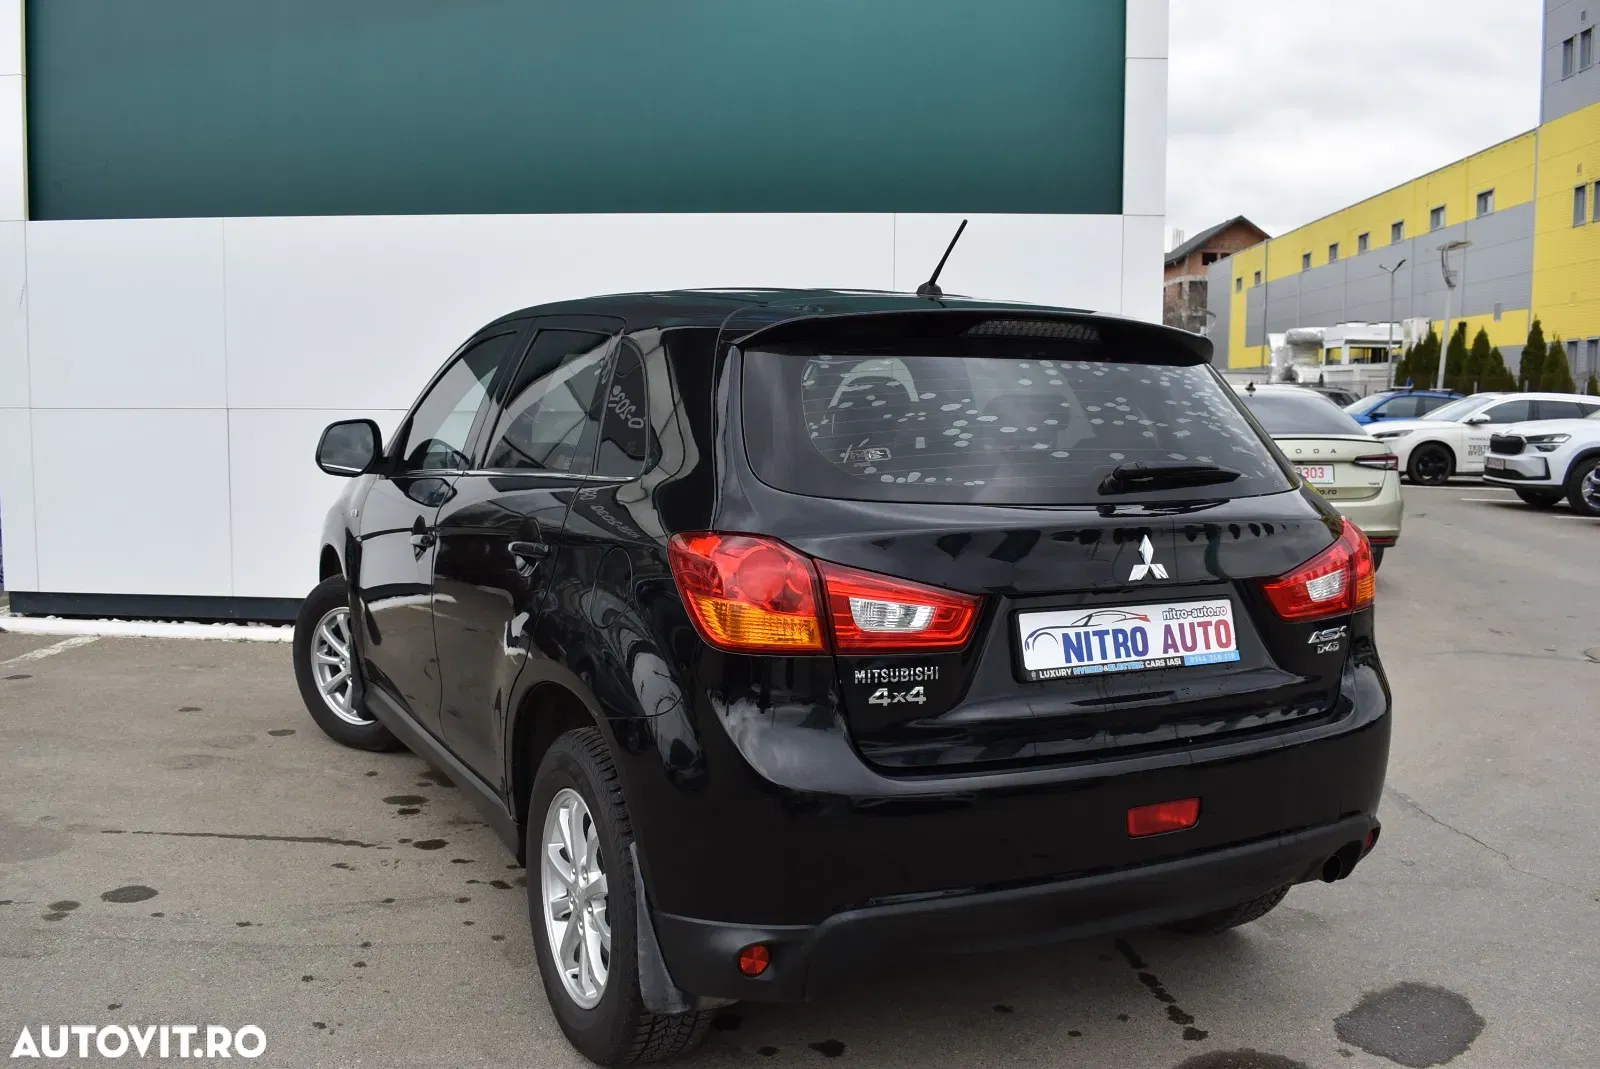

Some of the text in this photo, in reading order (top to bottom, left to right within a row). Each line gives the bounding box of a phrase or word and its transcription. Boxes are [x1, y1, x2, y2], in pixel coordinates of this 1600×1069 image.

[1162, 605, 1228, 621] nitro-auto.ro
[1062, 619, 1232, 664] NITRO AUTO
[1308, 625, 1347, 644] ASX
[854, 666, 939, 684] MITSUBISHI
[1039, 667, 1072, 679] LUXURY
[1145, 658, 1166, 668] CARS
[868, 686, 927, 707] 4x4
